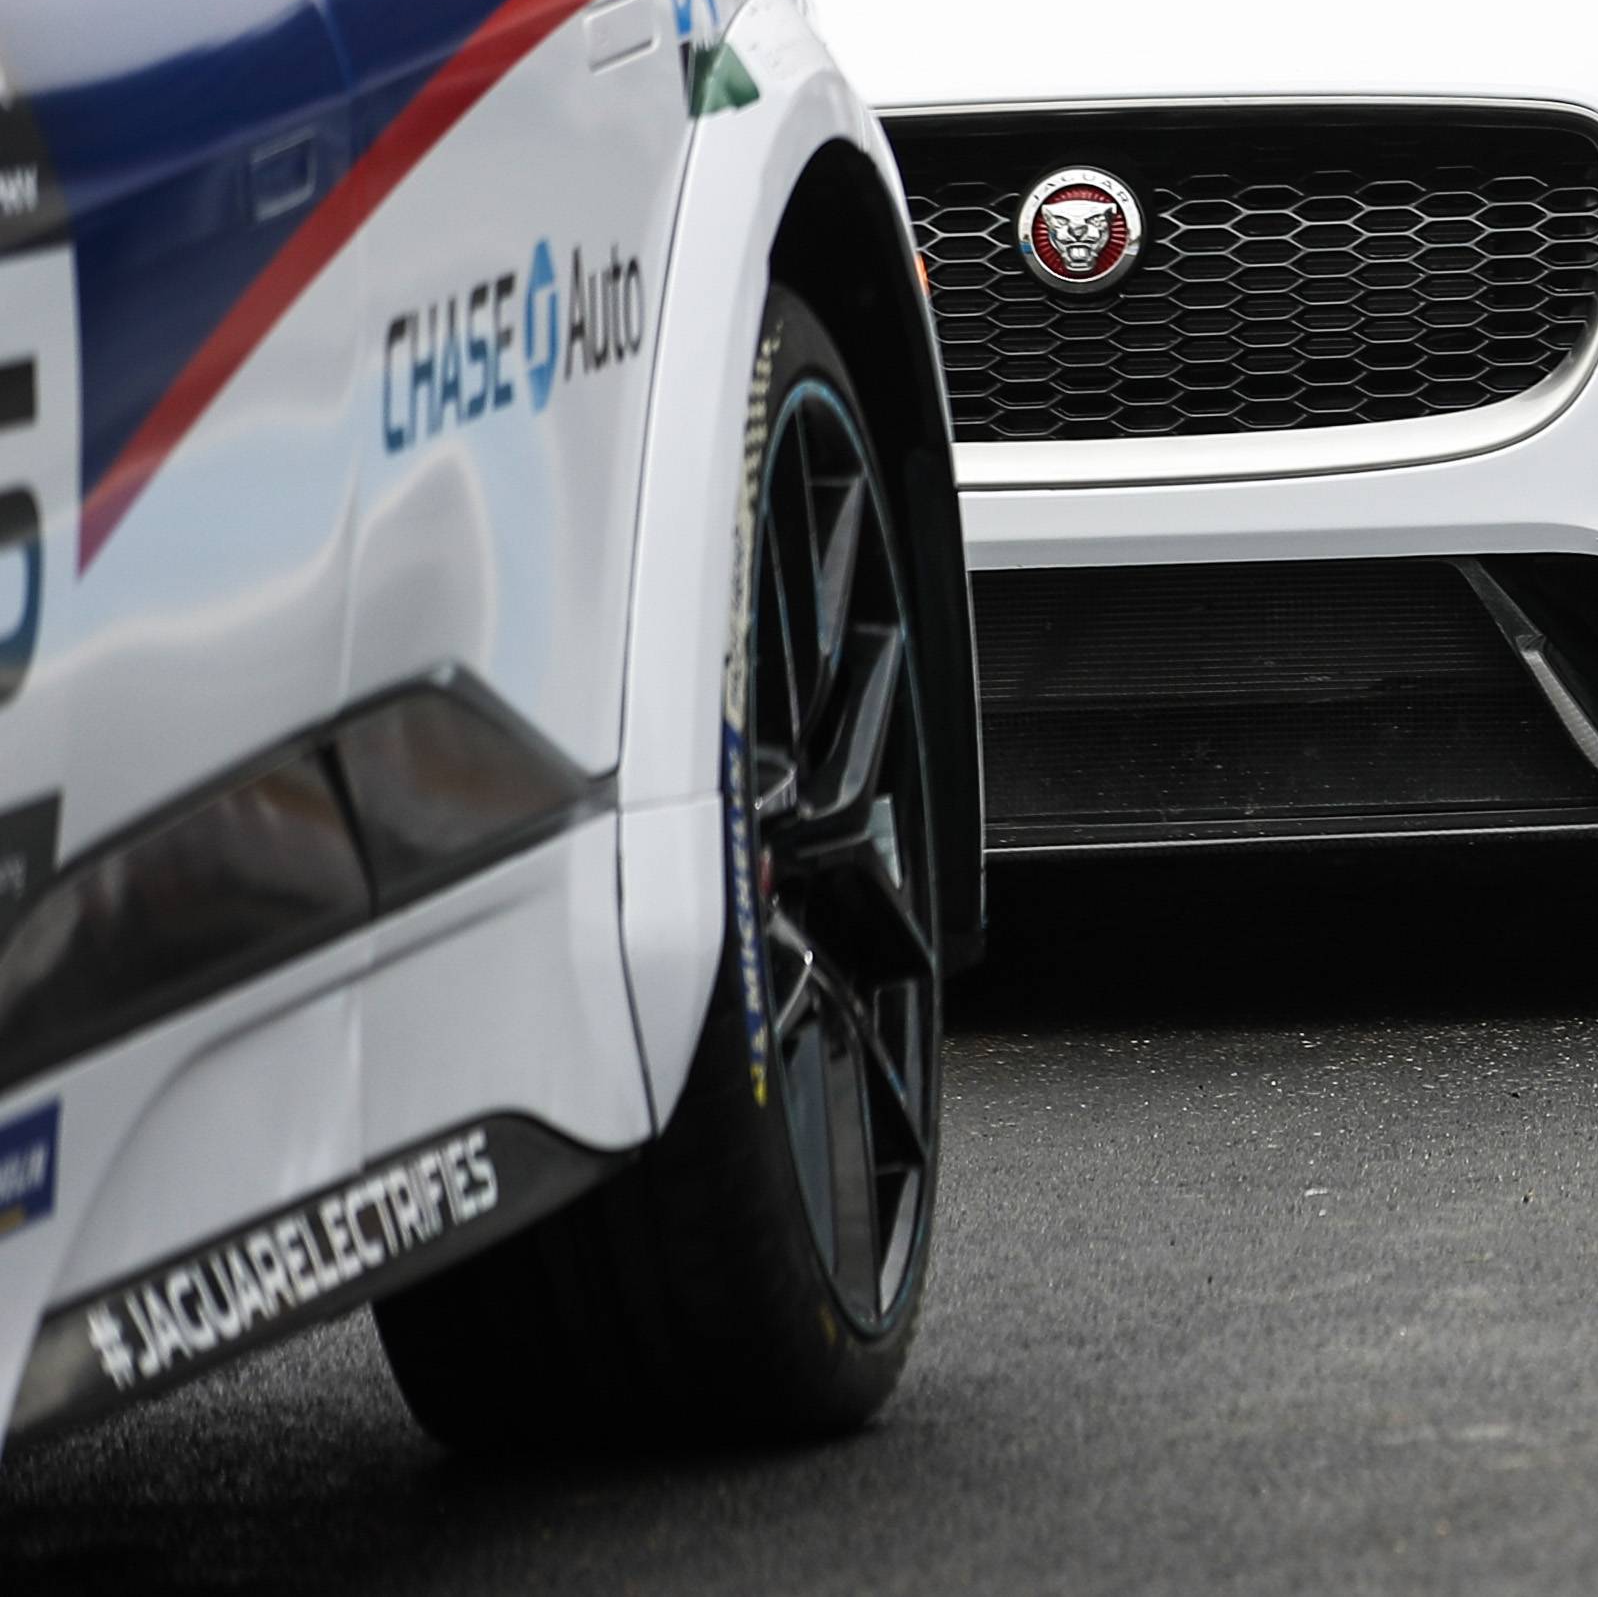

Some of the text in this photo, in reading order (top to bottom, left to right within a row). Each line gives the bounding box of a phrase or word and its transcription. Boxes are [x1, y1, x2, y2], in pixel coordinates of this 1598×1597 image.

[383, 244, 645, 455] CHASE Auto
[87, 1127, 498, 1392] #JAGUARELECTRIFIES
